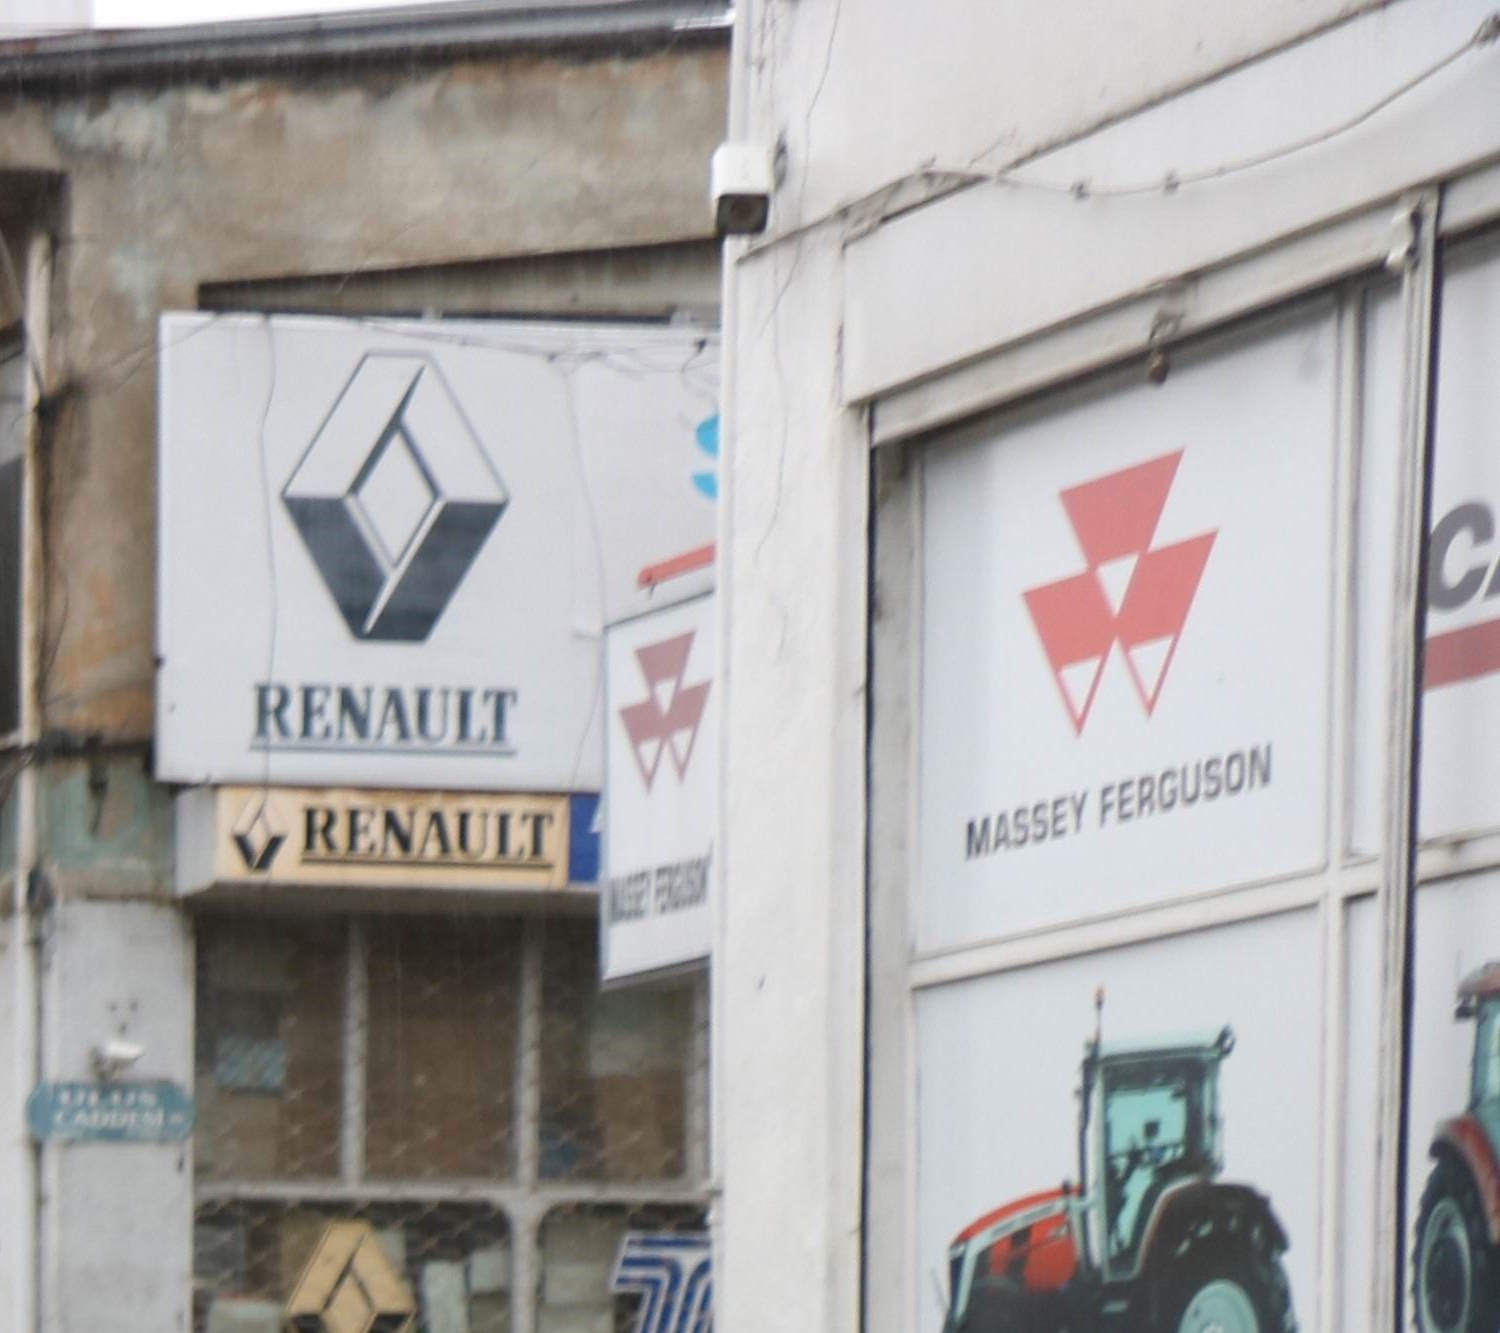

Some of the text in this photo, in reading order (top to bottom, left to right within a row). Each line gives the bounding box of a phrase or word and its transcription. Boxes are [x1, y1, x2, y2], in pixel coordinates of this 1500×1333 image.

[1426, 500, 1500, 612] C
[250, 684, 518, 746] RENAULT
[302, 790, 554, 862] RENAULT
[965, 742, 1274, 861] MASSEY FERGUSON
